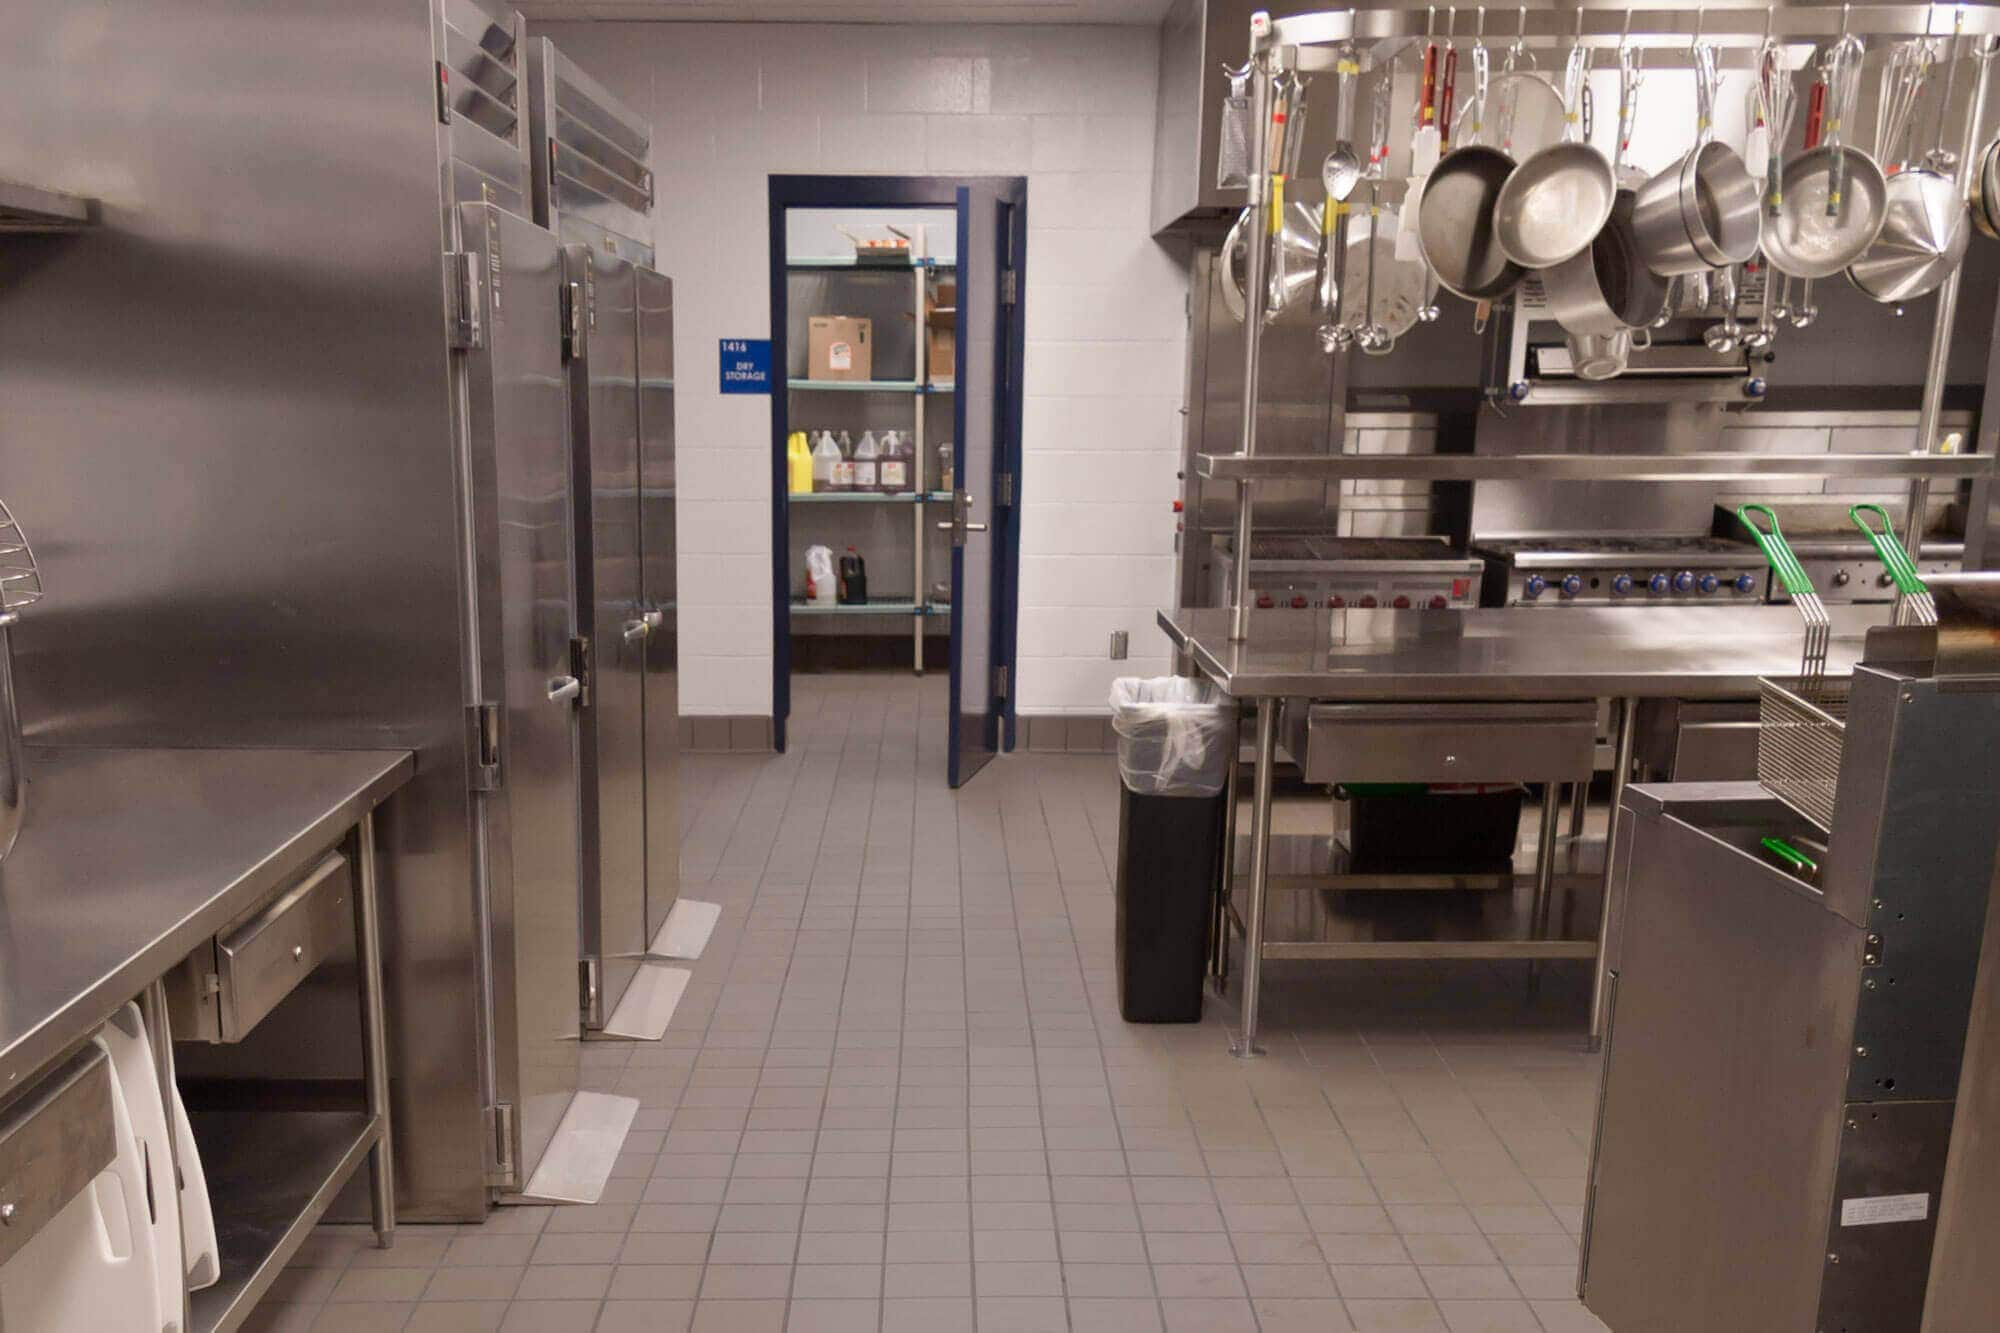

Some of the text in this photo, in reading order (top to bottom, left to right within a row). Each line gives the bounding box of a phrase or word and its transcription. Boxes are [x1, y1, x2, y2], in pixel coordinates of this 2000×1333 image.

[722, 341, 747, 352] 1416
[736, 361, 754, 370] DRY
[725, 371, 766, 381] STORAGE
